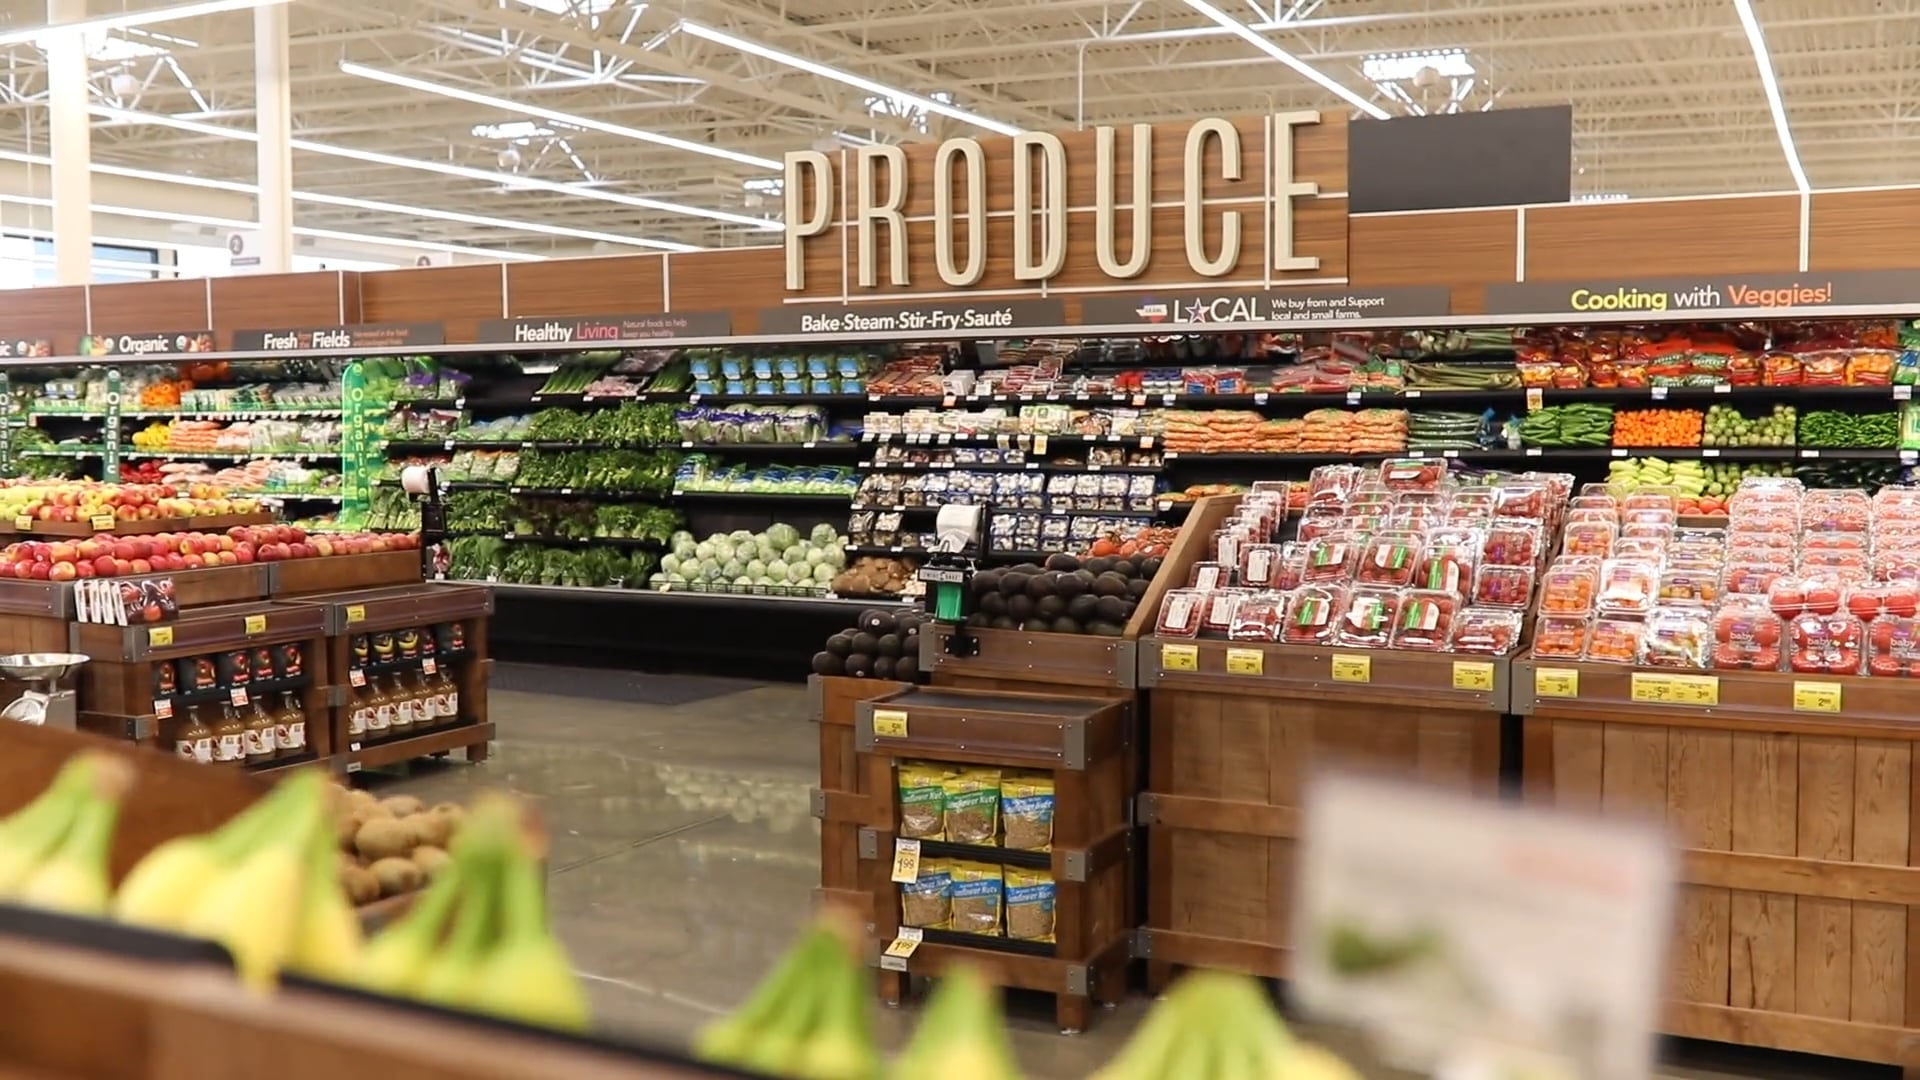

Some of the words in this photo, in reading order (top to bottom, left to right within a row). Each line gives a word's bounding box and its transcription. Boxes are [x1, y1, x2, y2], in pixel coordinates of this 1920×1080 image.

[784, 110, 1320, 291] PRODUCE
[1271, 298, 1287, 309] We
[1288, 298, 1305, 310] buy
[1307, 297, 1327, 308] from
[1329, 296, 1347, 307] and
[1348, 296, 1385, 309] Support
[1571, 287, 1667, 312] Cooking
[1674, 284, 1720, 307] with
[1728, 282, 1832, 308] Veggies!
[801, 314, 840, 332] Bake
[844, 313, 895, 331] Steam
[899, 310, 960, 330] Stir-Fry
[964, 307, 1013, 327] Sauté
[1271, 310, 1291, 321] local
[1293, 310, 1310, 320] and
[1311, 309, 1334, 320] small
[263, 331, 298, 350] Fresh
[312, 329, 350, 348] Fields
[515, 322, 573, 343] Healthy
[576, 321, 618, 341] Living
[119, 335, 169, 355] Organic
[107, 391, 120, 474] Organic
[352, 387, 366, 477] Organic
[1890, 637, 1917, 649] baby
